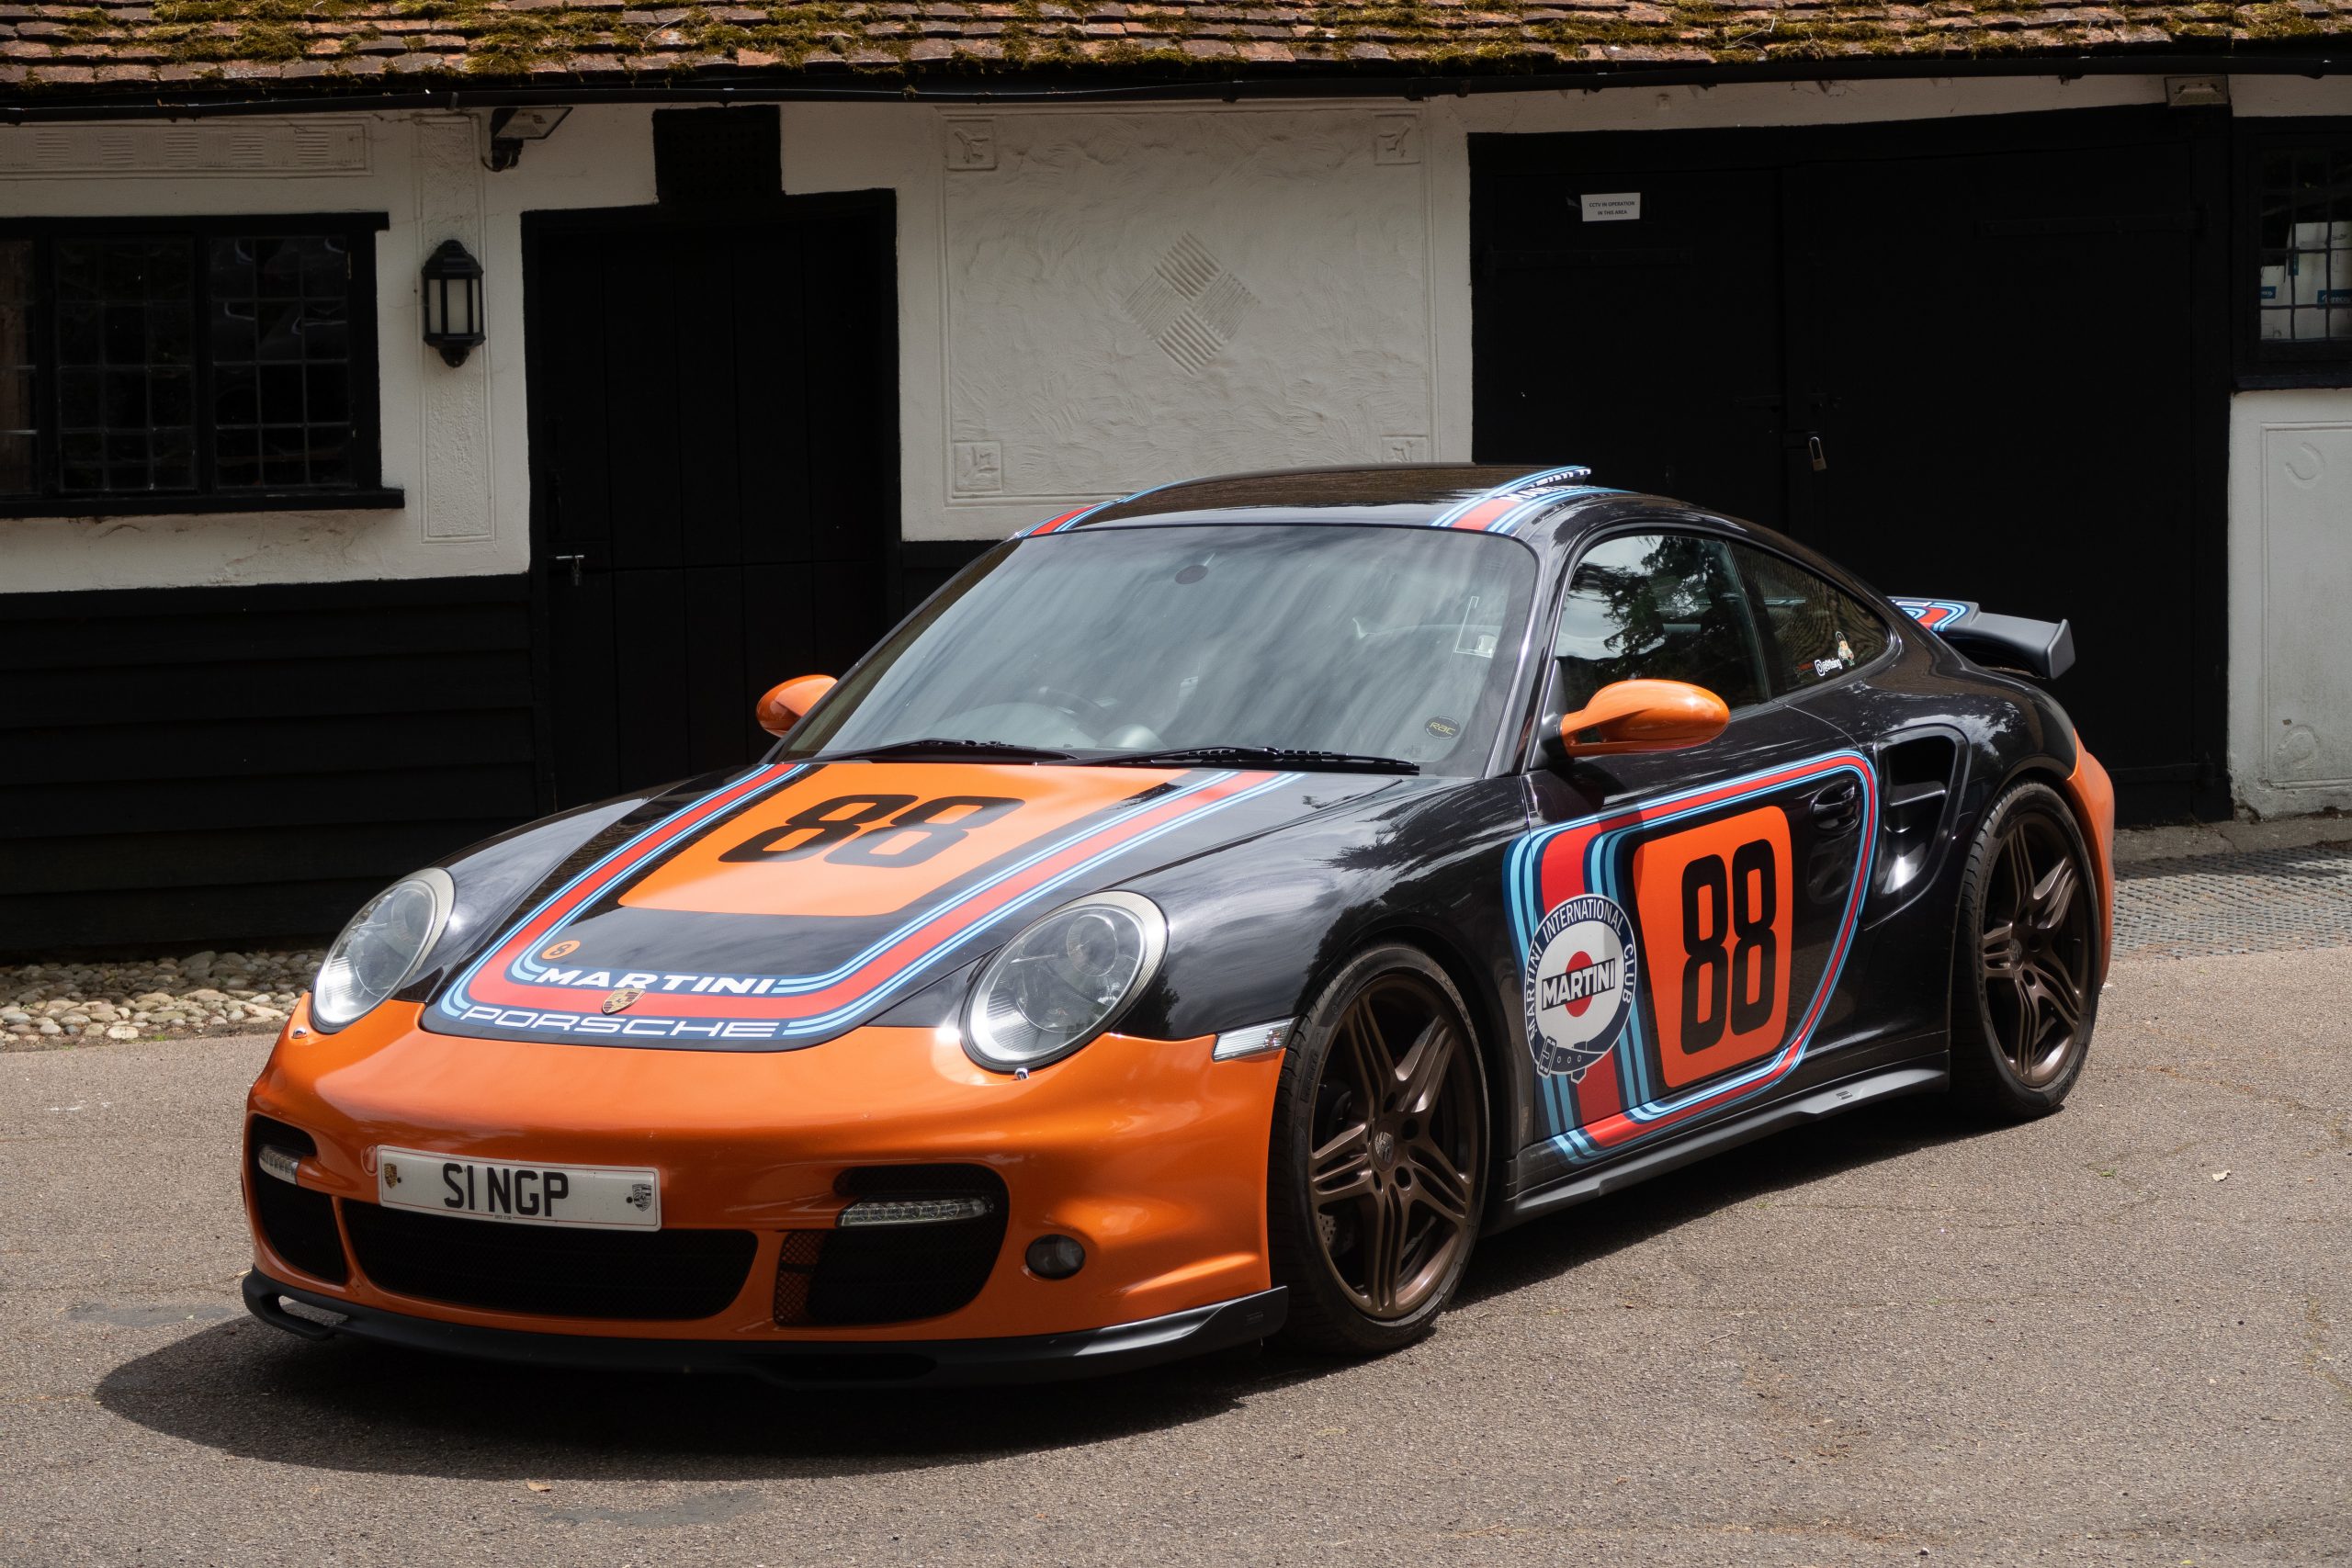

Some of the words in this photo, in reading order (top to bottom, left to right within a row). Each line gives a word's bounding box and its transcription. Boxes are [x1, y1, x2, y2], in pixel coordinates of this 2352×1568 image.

[718, 794, 1025, 867] 88
[1526, 941, 1543, 1042] MARTINI
[1543, 898, 1624, 943] INTERNATIONAL
[1622, 943, 1635, 1004] CLUB
[1680, 839, 1777, 1055] 88
[534, 967, 775, 994] MARTINI
[1544, 960, 1615, 1010] MARTINI
[460, 1005, 780, 1038] PORSCHE
